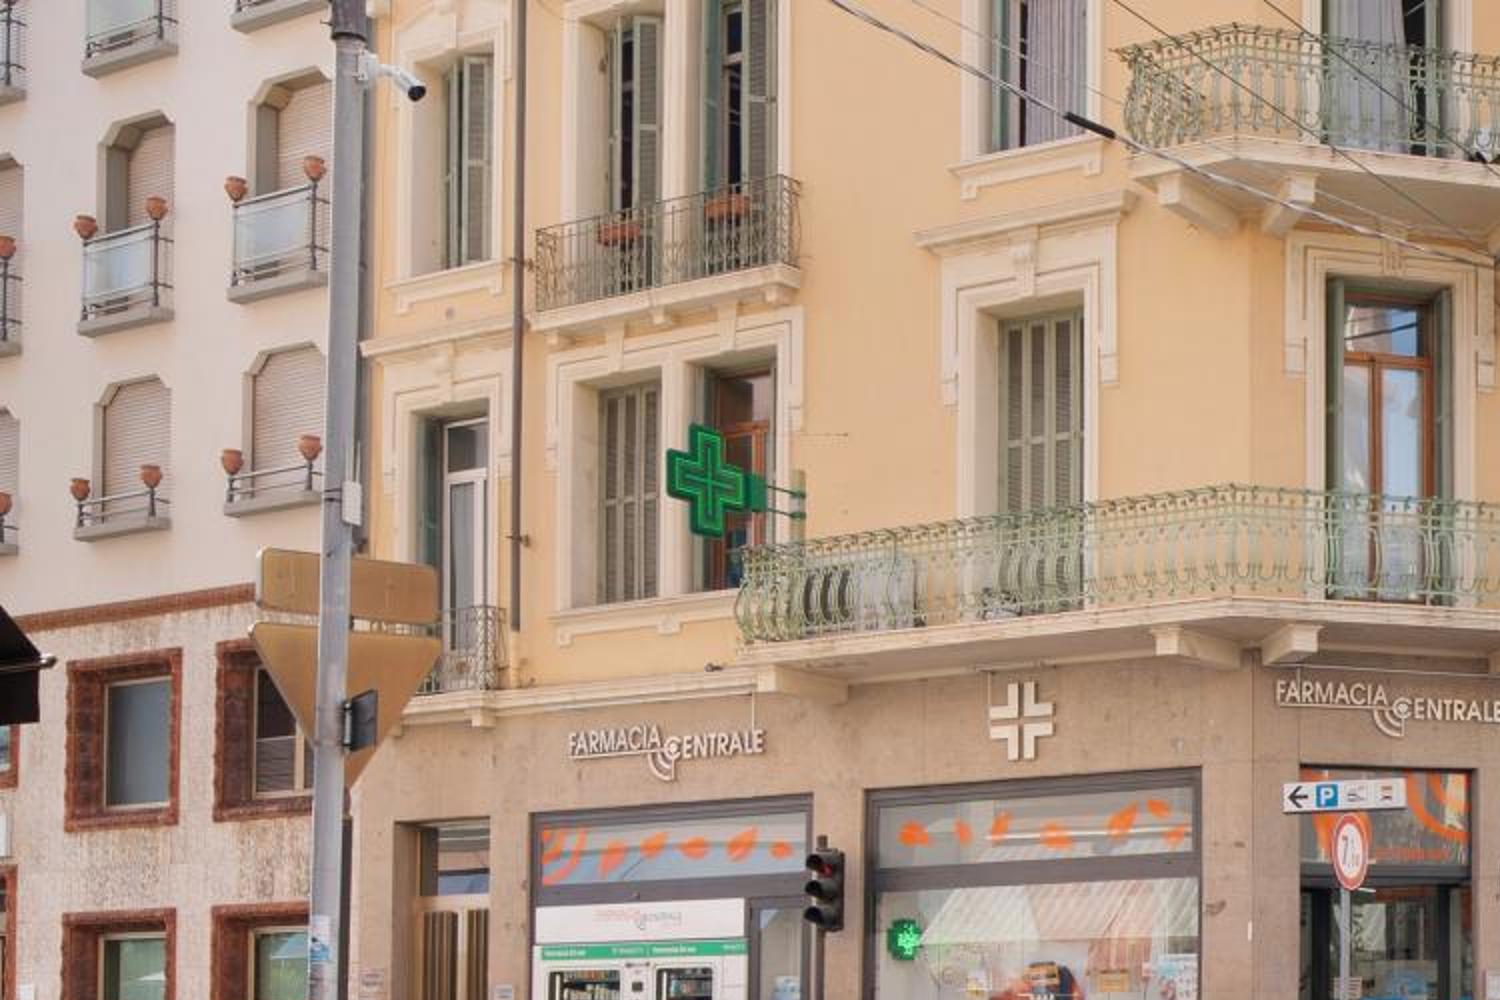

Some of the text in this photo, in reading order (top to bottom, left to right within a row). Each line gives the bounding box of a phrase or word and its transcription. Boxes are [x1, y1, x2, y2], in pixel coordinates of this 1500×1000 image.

[1276, 679, 1388, 705] FARMACIA
[568, 724, 767, 760] FARMACIA CENTRALE
